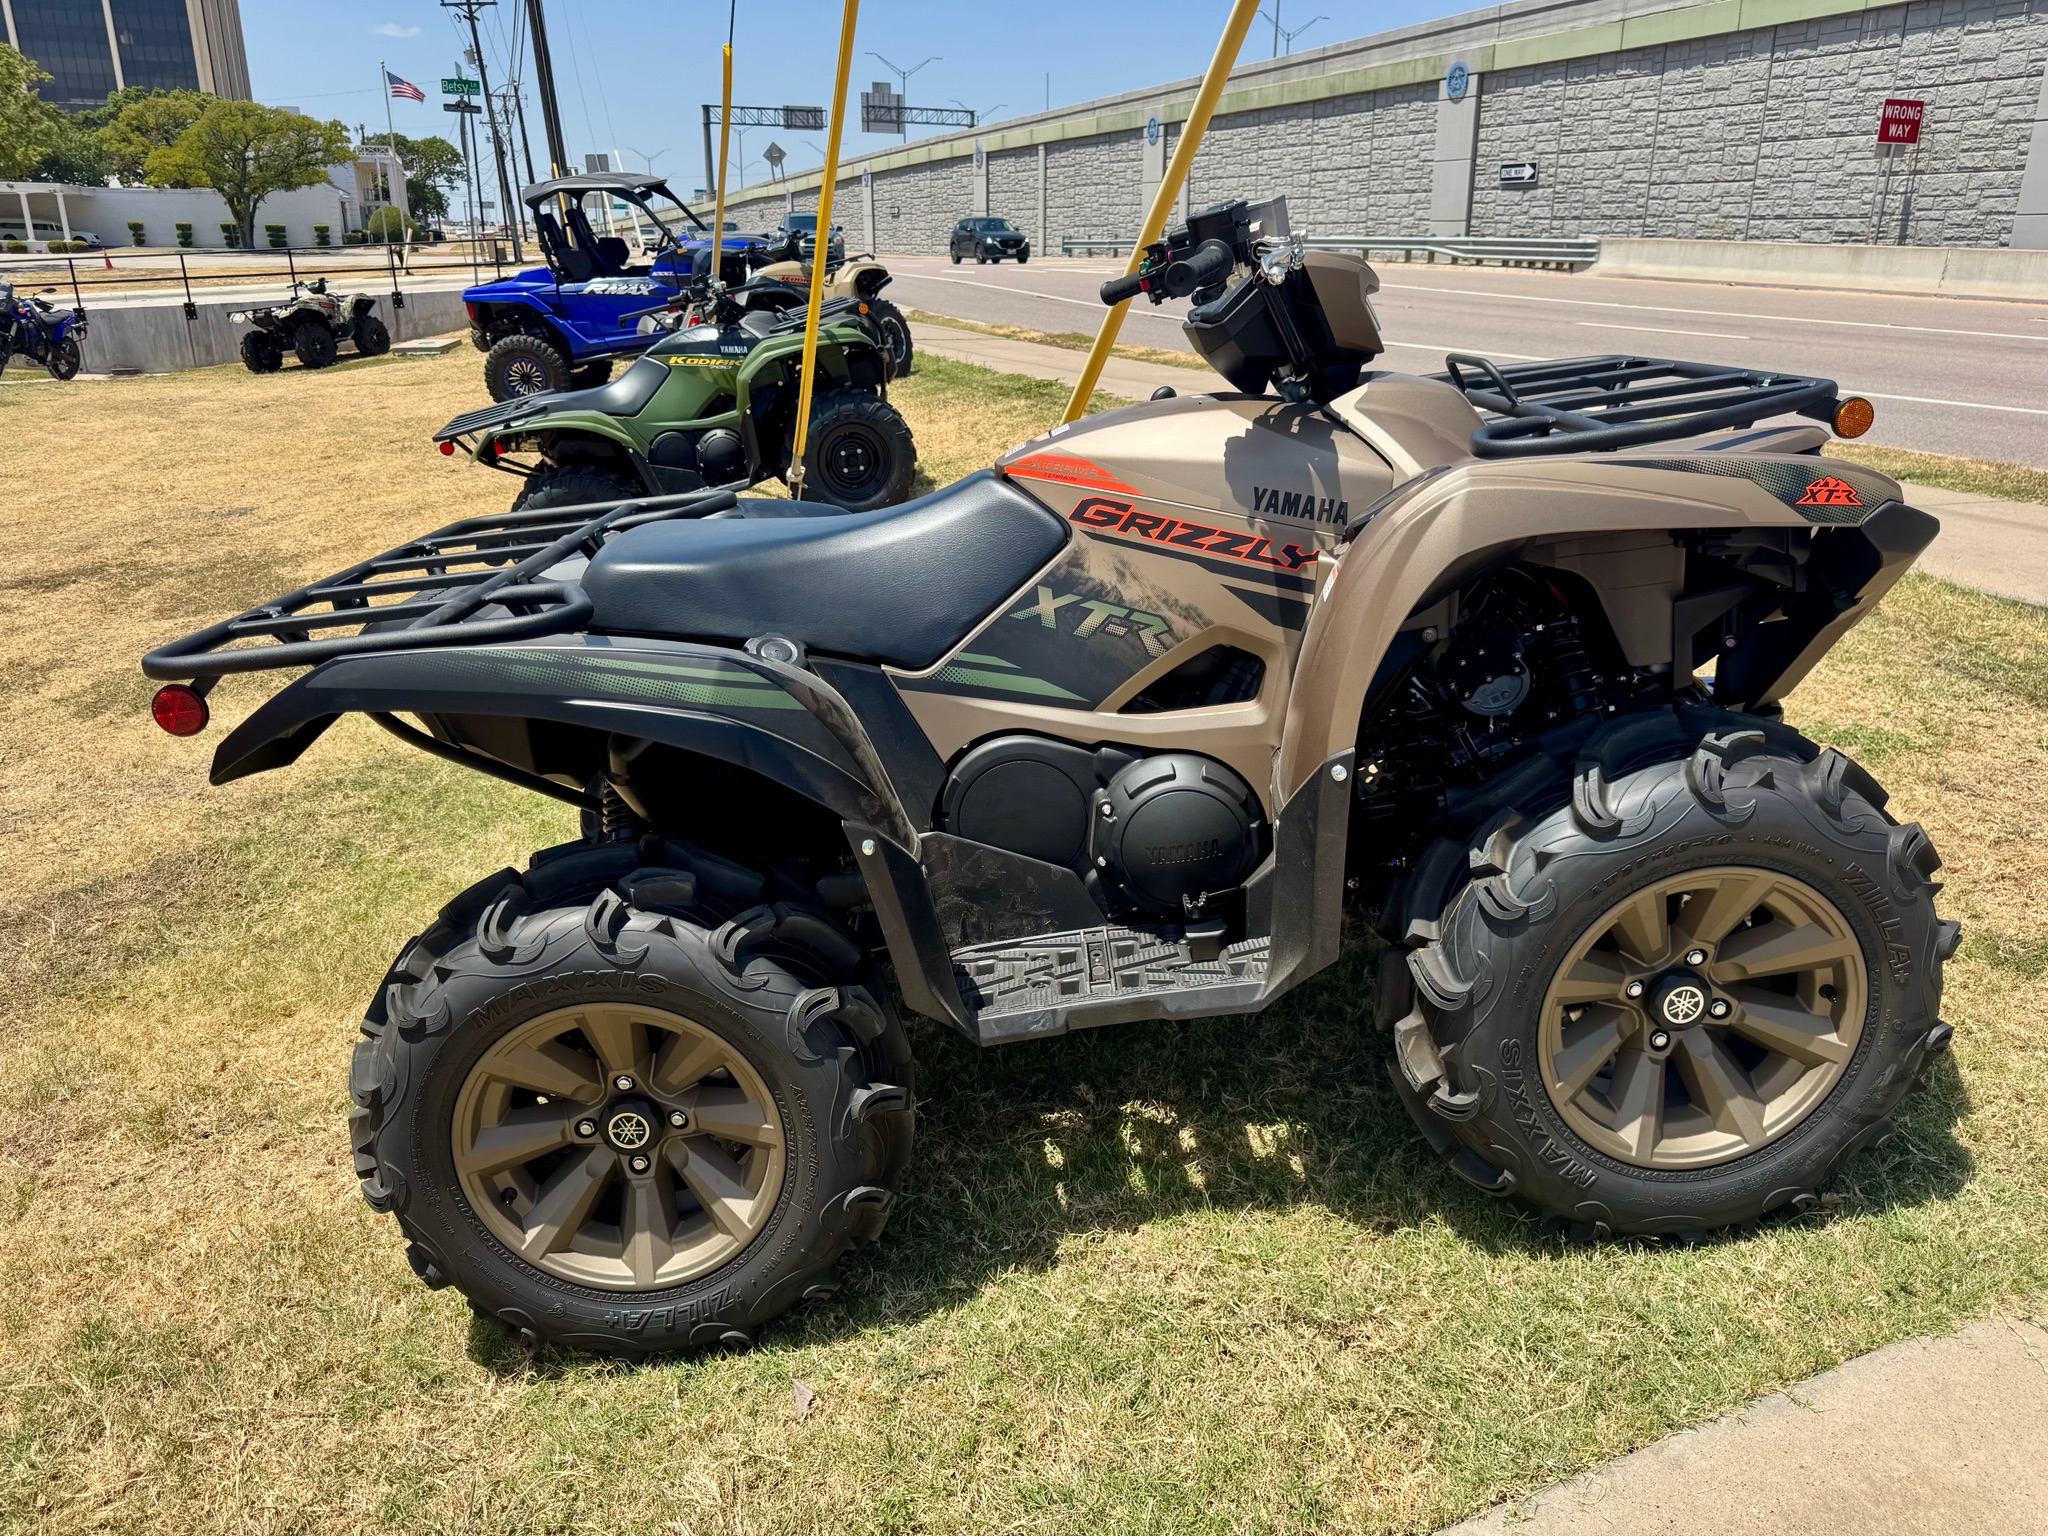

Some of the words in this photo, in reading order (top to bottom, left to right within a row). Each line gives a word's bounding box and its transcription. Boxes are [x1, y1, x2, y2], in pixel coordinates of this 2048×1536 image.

[443, 81, 468, 93] Betsy
[1885, 105, 1921, 120] WRONG
[1889, 123, 1911, 138] WAY
[582, 283, 659, 296] RMAX
[720, 345, 748, 354] YAMAHA
[669, 356, 744, 367] KODIAK
[1030, 459, 1099, 476] XTREME
[1043, 472, 1077, 482] TERRAIN
[1801, 488, 1858, 504] XT-R
[1253, 486, 1349, 526] YAMAHA
[1068, 497, 1320, 571] GRIZZLY
[1145, 838, 1222, 865] YAMAHA
[467, 969, 670, 1029] MAXXIS
[1499, 1038, 1600, 1189] MAXXIS
